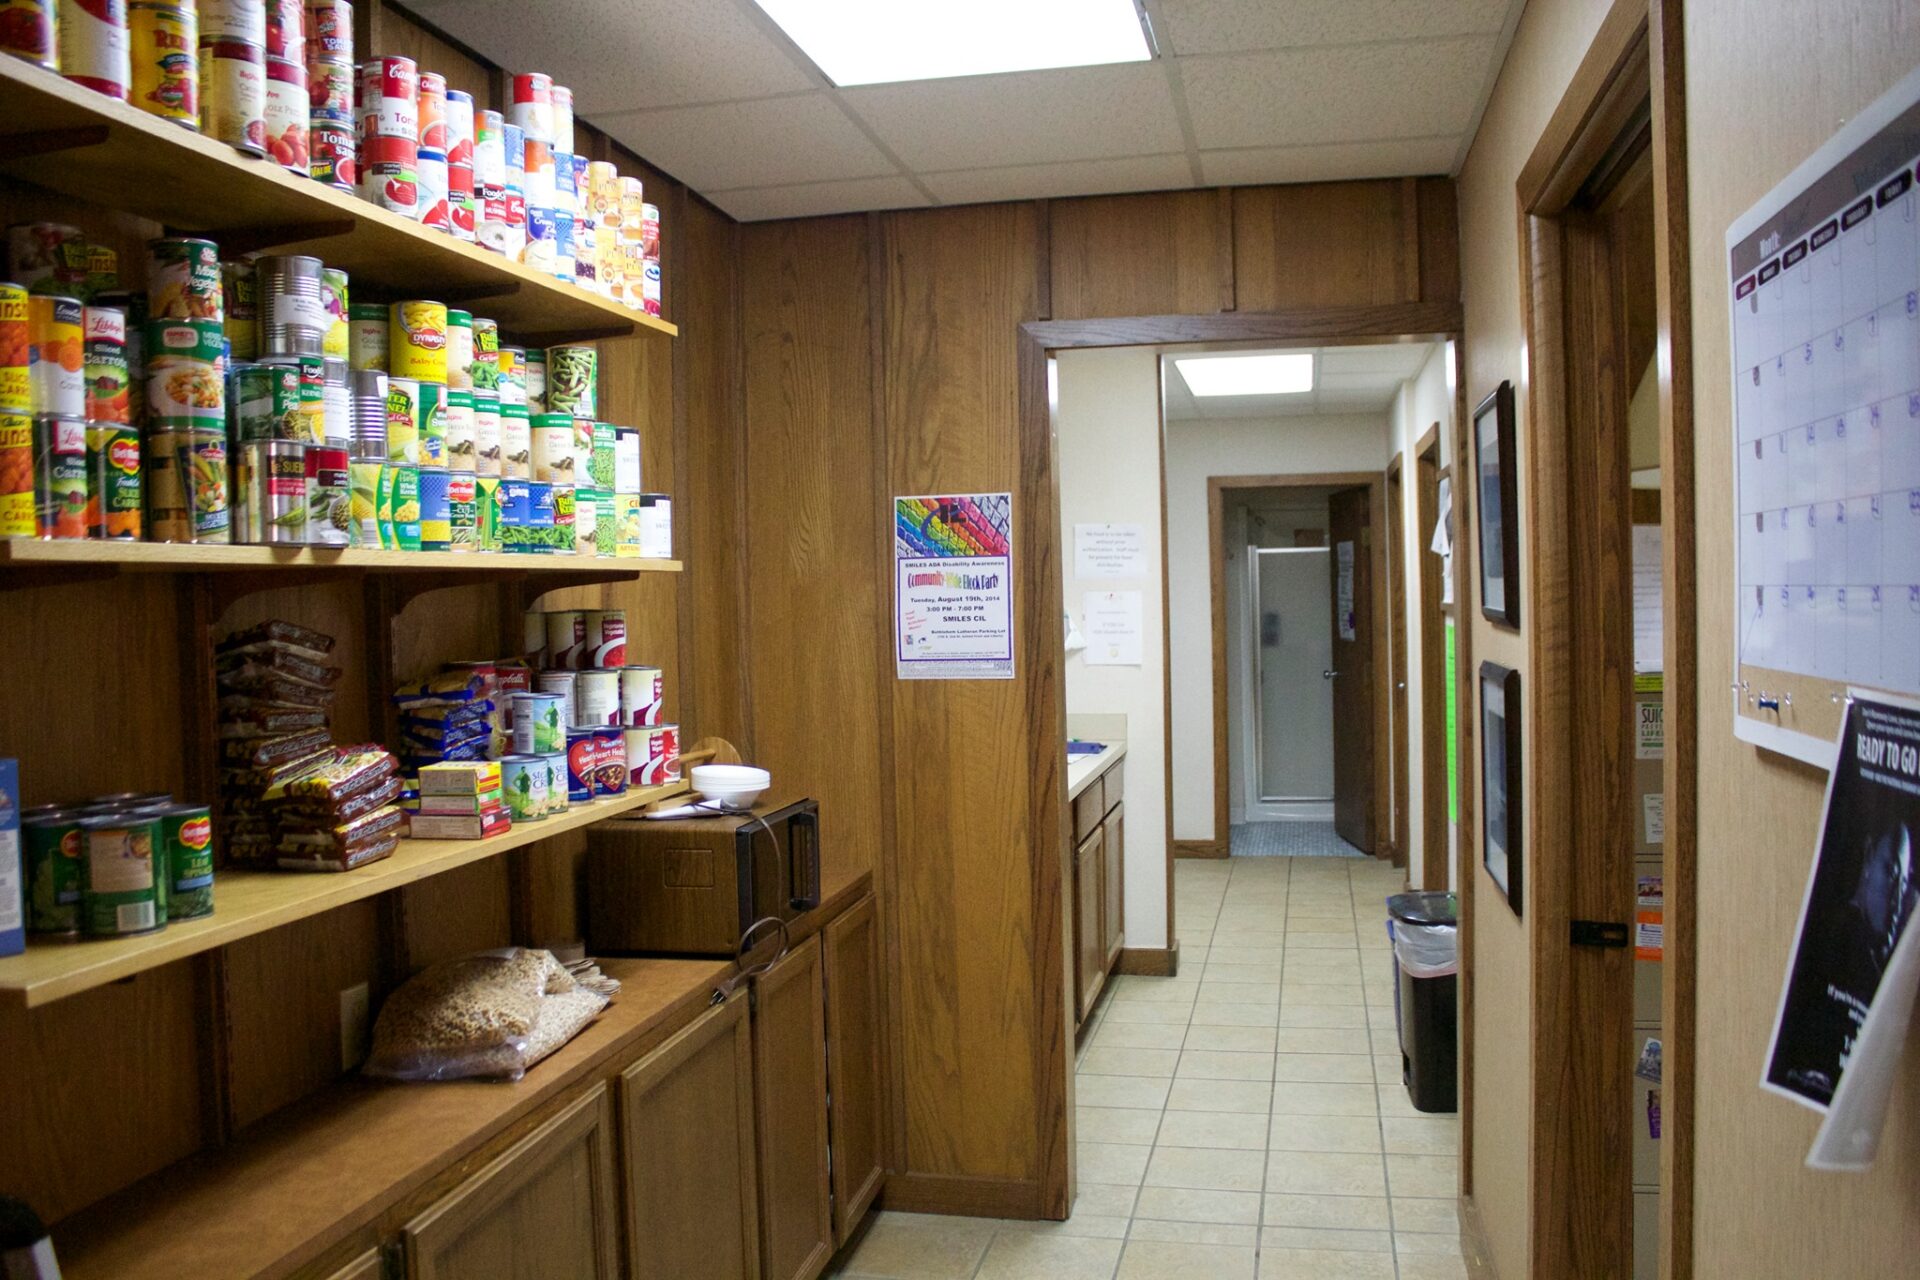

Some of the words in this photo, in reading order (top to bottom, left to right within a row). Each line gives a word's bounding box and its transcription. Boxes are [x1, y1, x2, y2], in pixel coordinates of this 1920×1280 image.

[1856, 732, 1886, 767] READY
[1886, 740, 1900, 771] TO
[1900, 744, 1917, 776] GO
